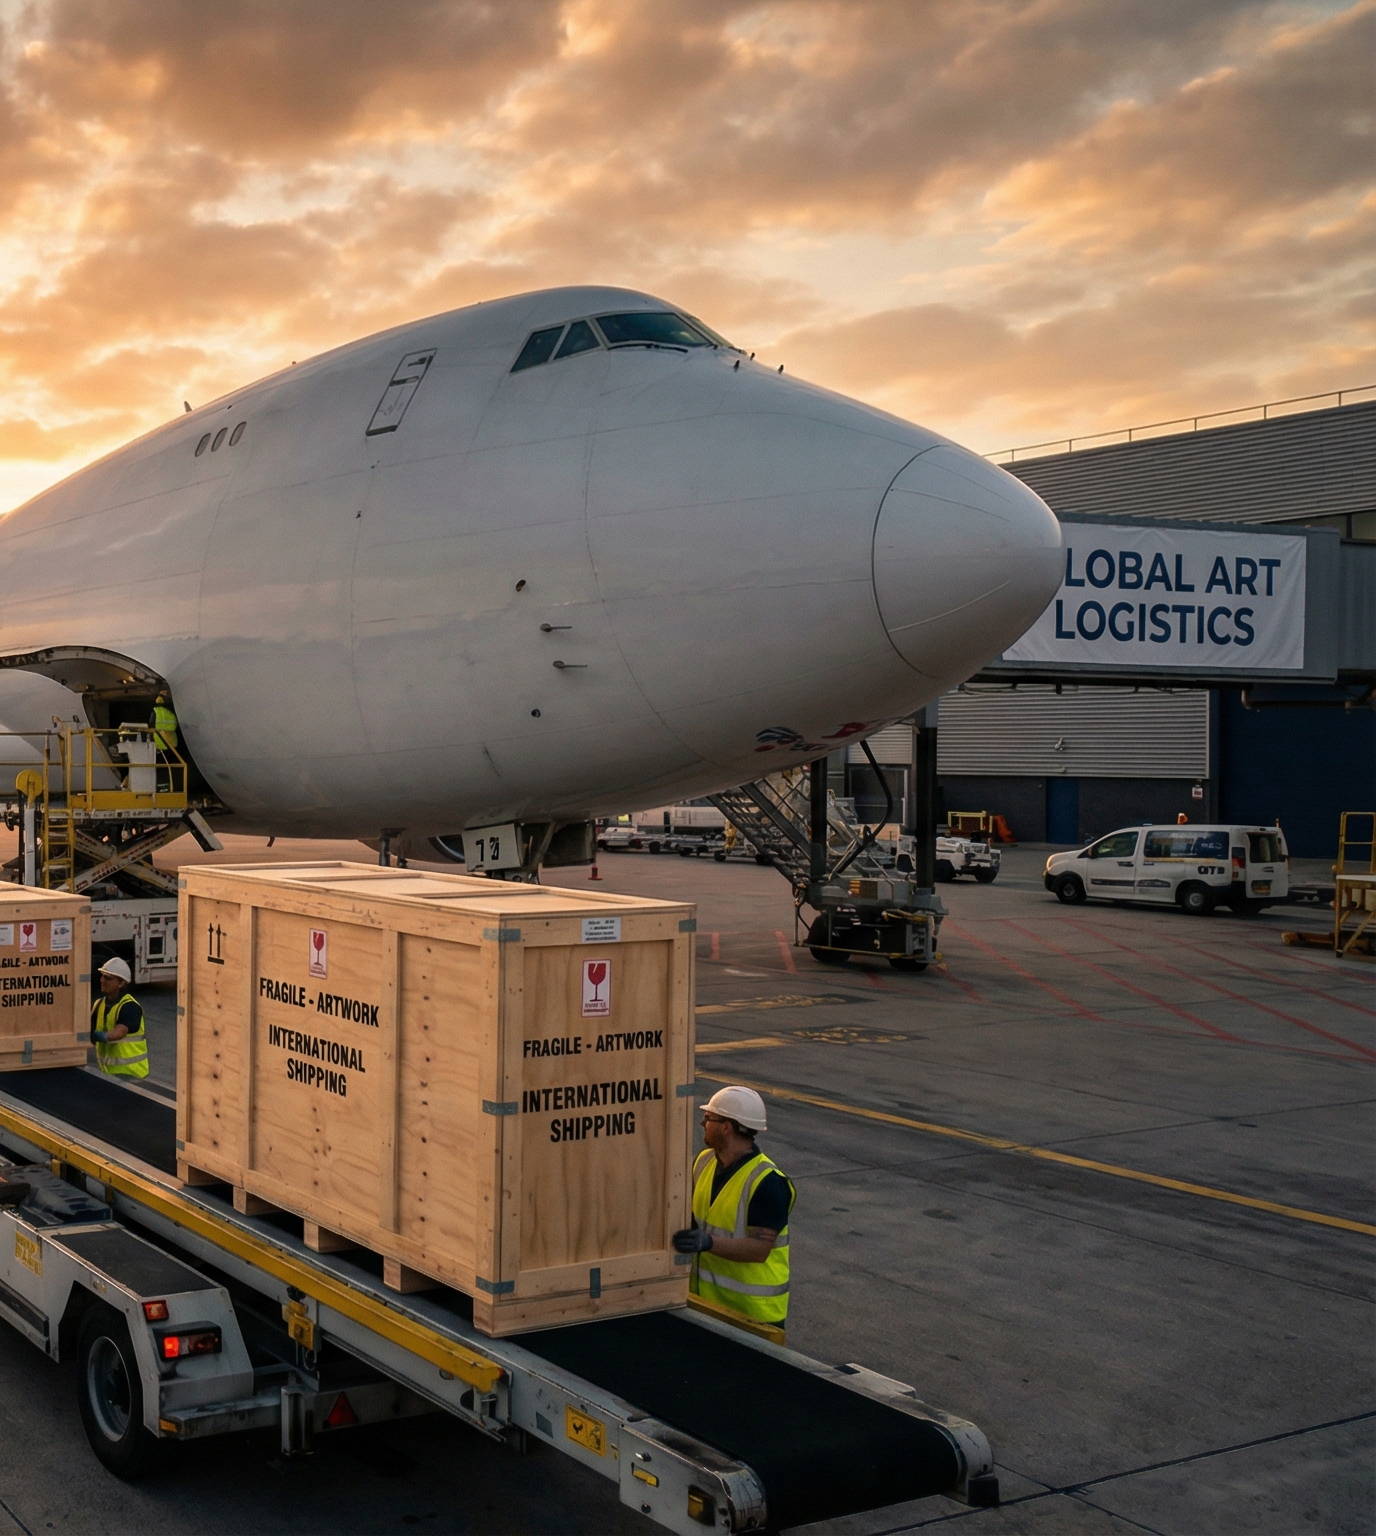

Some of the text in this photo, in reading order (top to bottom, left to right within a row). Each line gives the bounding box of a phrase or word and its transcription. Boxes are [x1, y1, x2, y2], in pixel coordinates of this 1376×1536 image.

[1064, 547, 1282, 597] LOBAL ART
[1055, 599, 1255, 647] LOGISTICS
[1, 991, 54, 1008] SHIPPING
[259, 976, 306, 1008] FRAGILE
[317, 991, 380, 1028] ARTWORK
[269, 1023, 366, 1074] INTERNATIONAL
[523, 1036, 582, 1058] FRAGILE
[595, 1029, 663, 1053] ARTWORK
[287, 1057, 347, 1098] SHIPPING
[522, 1077, 663, 1114] INTERNATIONAL
[550, 1111, 636, 1143] SHIPPING
